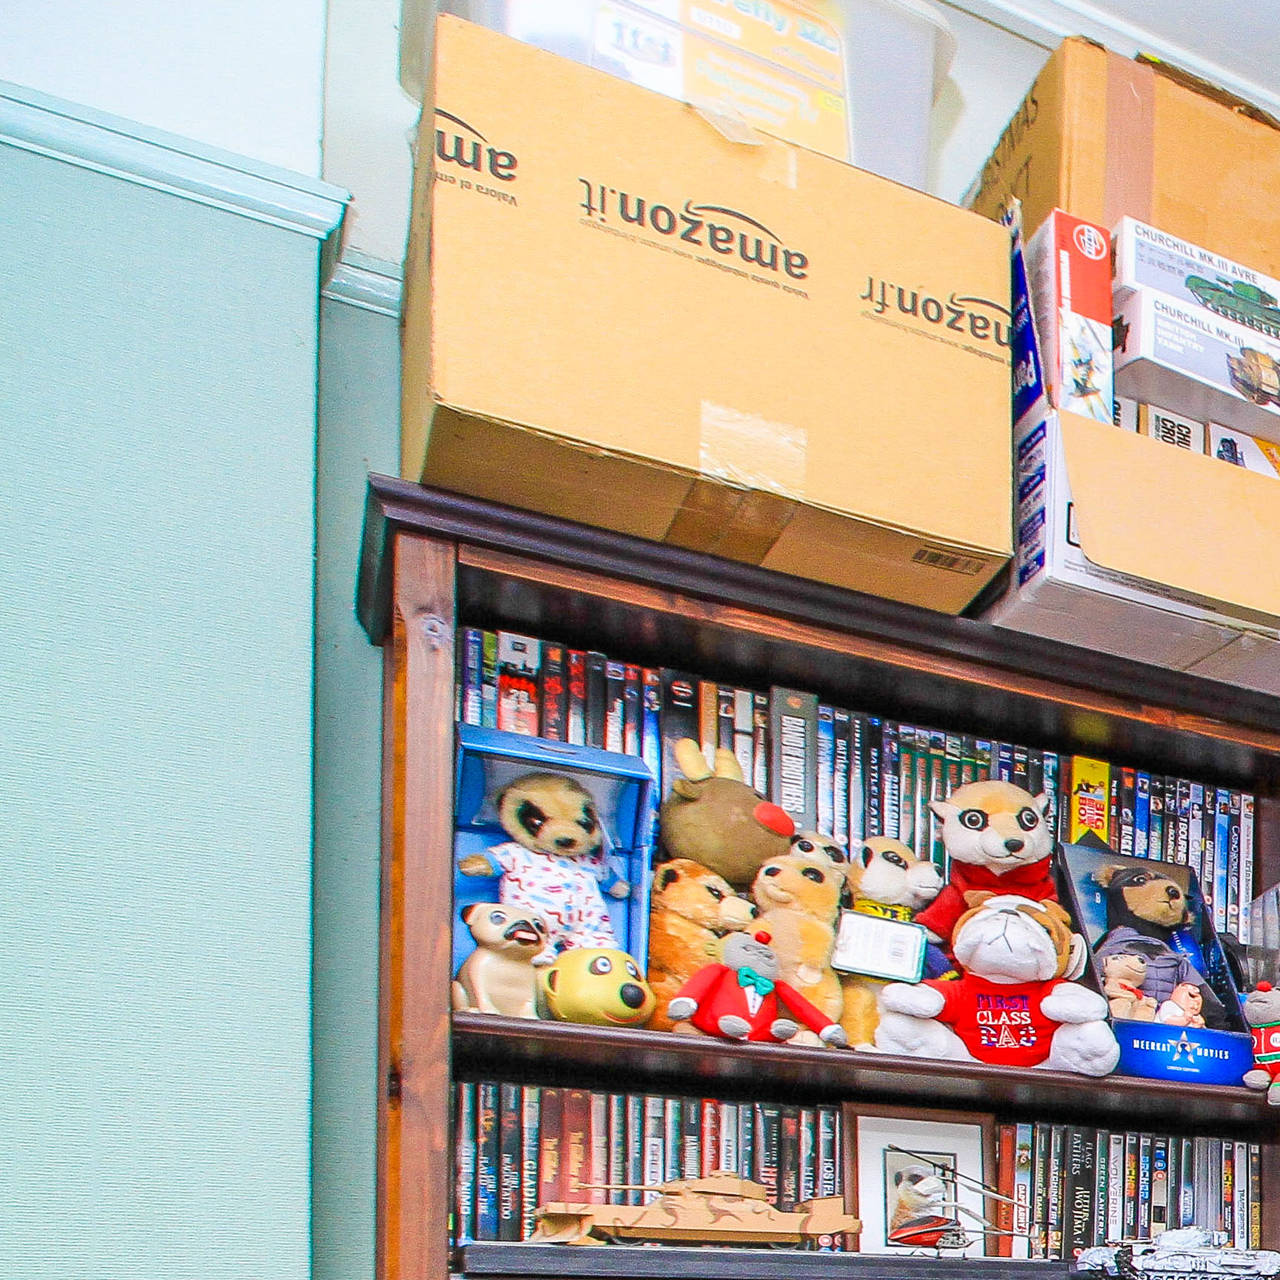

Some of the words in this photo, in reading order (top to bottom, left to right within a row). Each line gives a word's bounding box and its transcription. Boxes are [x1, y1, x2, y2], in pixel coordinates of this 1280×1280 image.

[578, 177, 809, 281] amazon.it
[1134, 224, 1196, 260] CHURCHILL
[1198, 250, 1229, 273] MK.III
[1231, 265, 1258, 284] AVRE
[860, 277, 1012, 348] mazon.fr
[1153, 299, 1214, 336] CHURCHILL
[1216, 327, 1245, 347] MK.III
[781, 716, 805, 747] BAND
[781, 757, 805, 814] BROTHERS
[1078, 797, 1087, 825] BOX
[1094, 802, 1105, 830] BIG
[1121, 824, 1134, 851] BLACK
[1177, 822, 1188, 863] BOURNE
[976, 993, 1029, 1010] FIRST
[976, 1010, 1030, 1025] CLASS
[980, 1025, 1037, 1048] DAD
[1133, 1039, 1170, 1054] MEERKAT
[1197, 1046, 1229, 1060] MOVIES
[1072, 1133, 1082, 1175] FATHERS
[1085, 1142, 1093, 1169] FLAGS
[511, 1171, 520, 1189] GIRL
[1050, 1159, 1058, 1204] CATCHING
[1110, 1155, 1118, 1225] WOLVERINE
[1141, 1156, 1149, 1200] ARCHER
[1224, 1160, 1232, 1202] ARCHER
[502, 1187, 511, 1219] TATTOO
[523, 1160, 536, 1241] GLADIATOR
[1017, 1184, 1027, 1205] DAD'S
[1018, 1207, 1027, 1228] ARMY
[1072, 1210, 1083, 1235] JIMA
[1098, 1192, 1106, 1235] LANTERN
